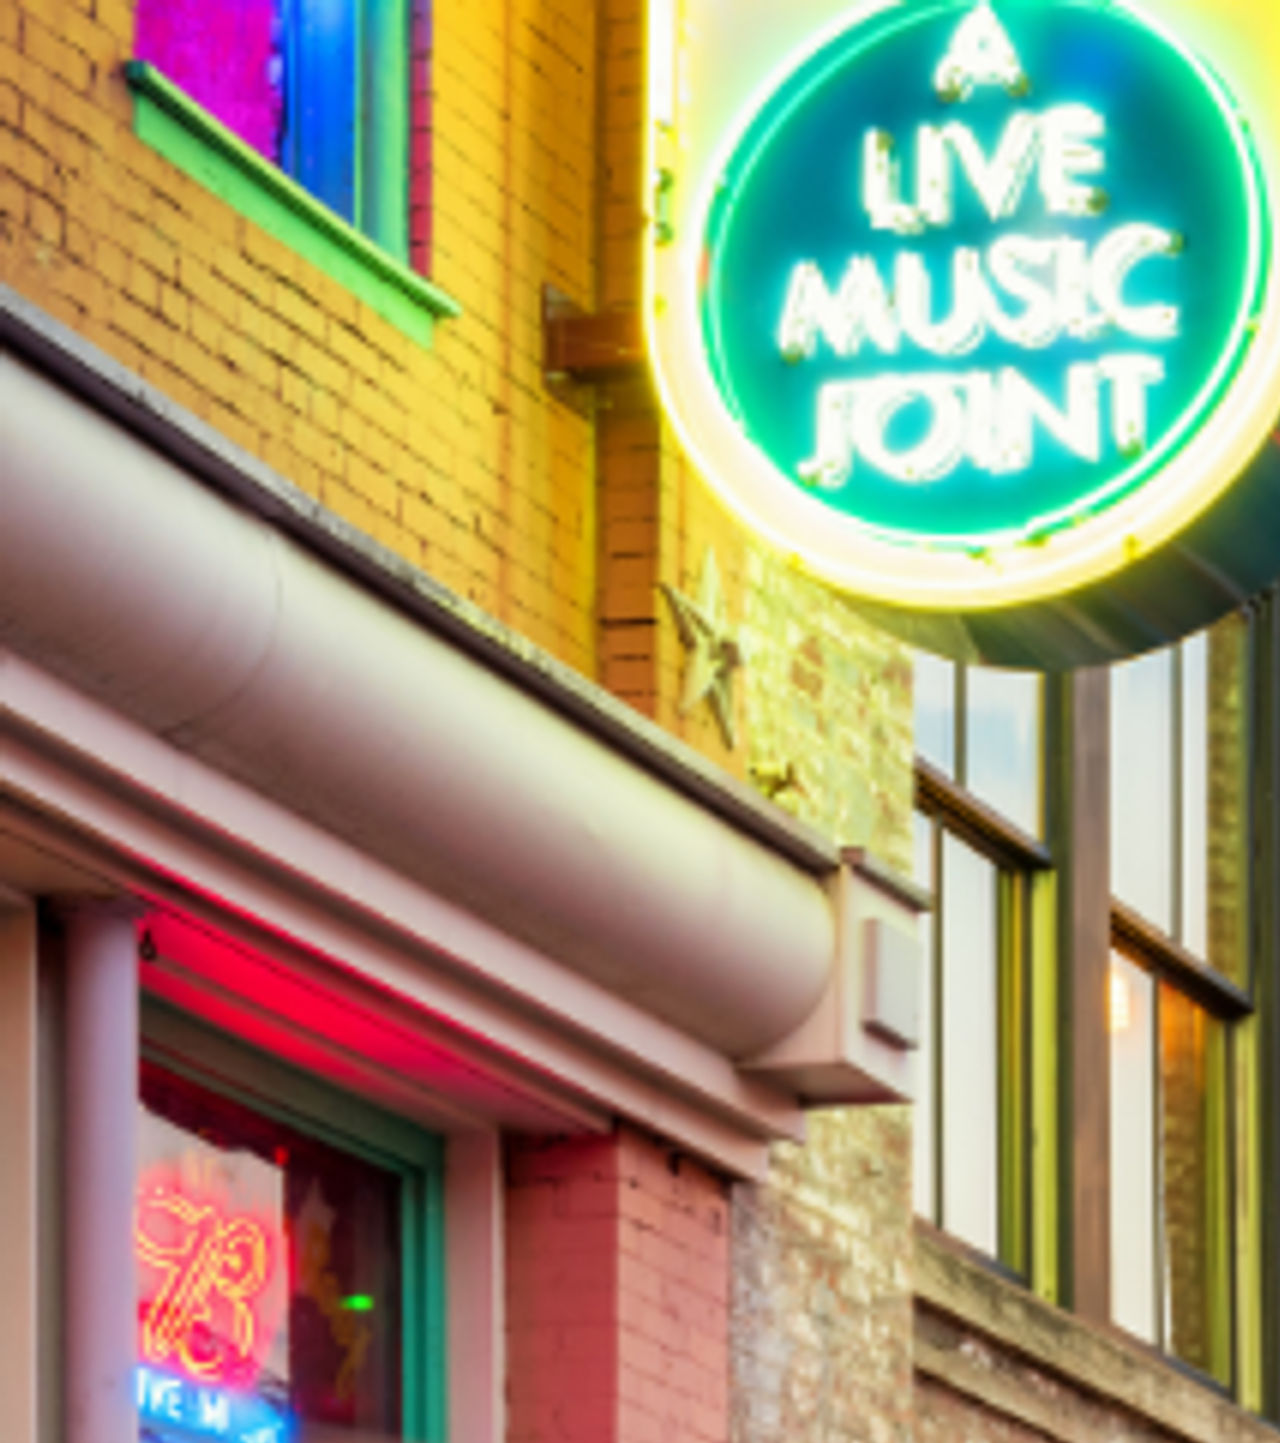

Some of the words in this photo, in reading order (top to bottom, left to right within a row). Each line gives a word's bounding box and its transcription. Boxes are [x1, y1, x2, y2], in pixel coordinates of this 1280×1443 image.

[934, 0, 1030, 102] A
[862, 102, 1110, 232] LIVE
[777, 222, 1188, 362] MUSIC
[798, 354, 1167, 490] JOINT
